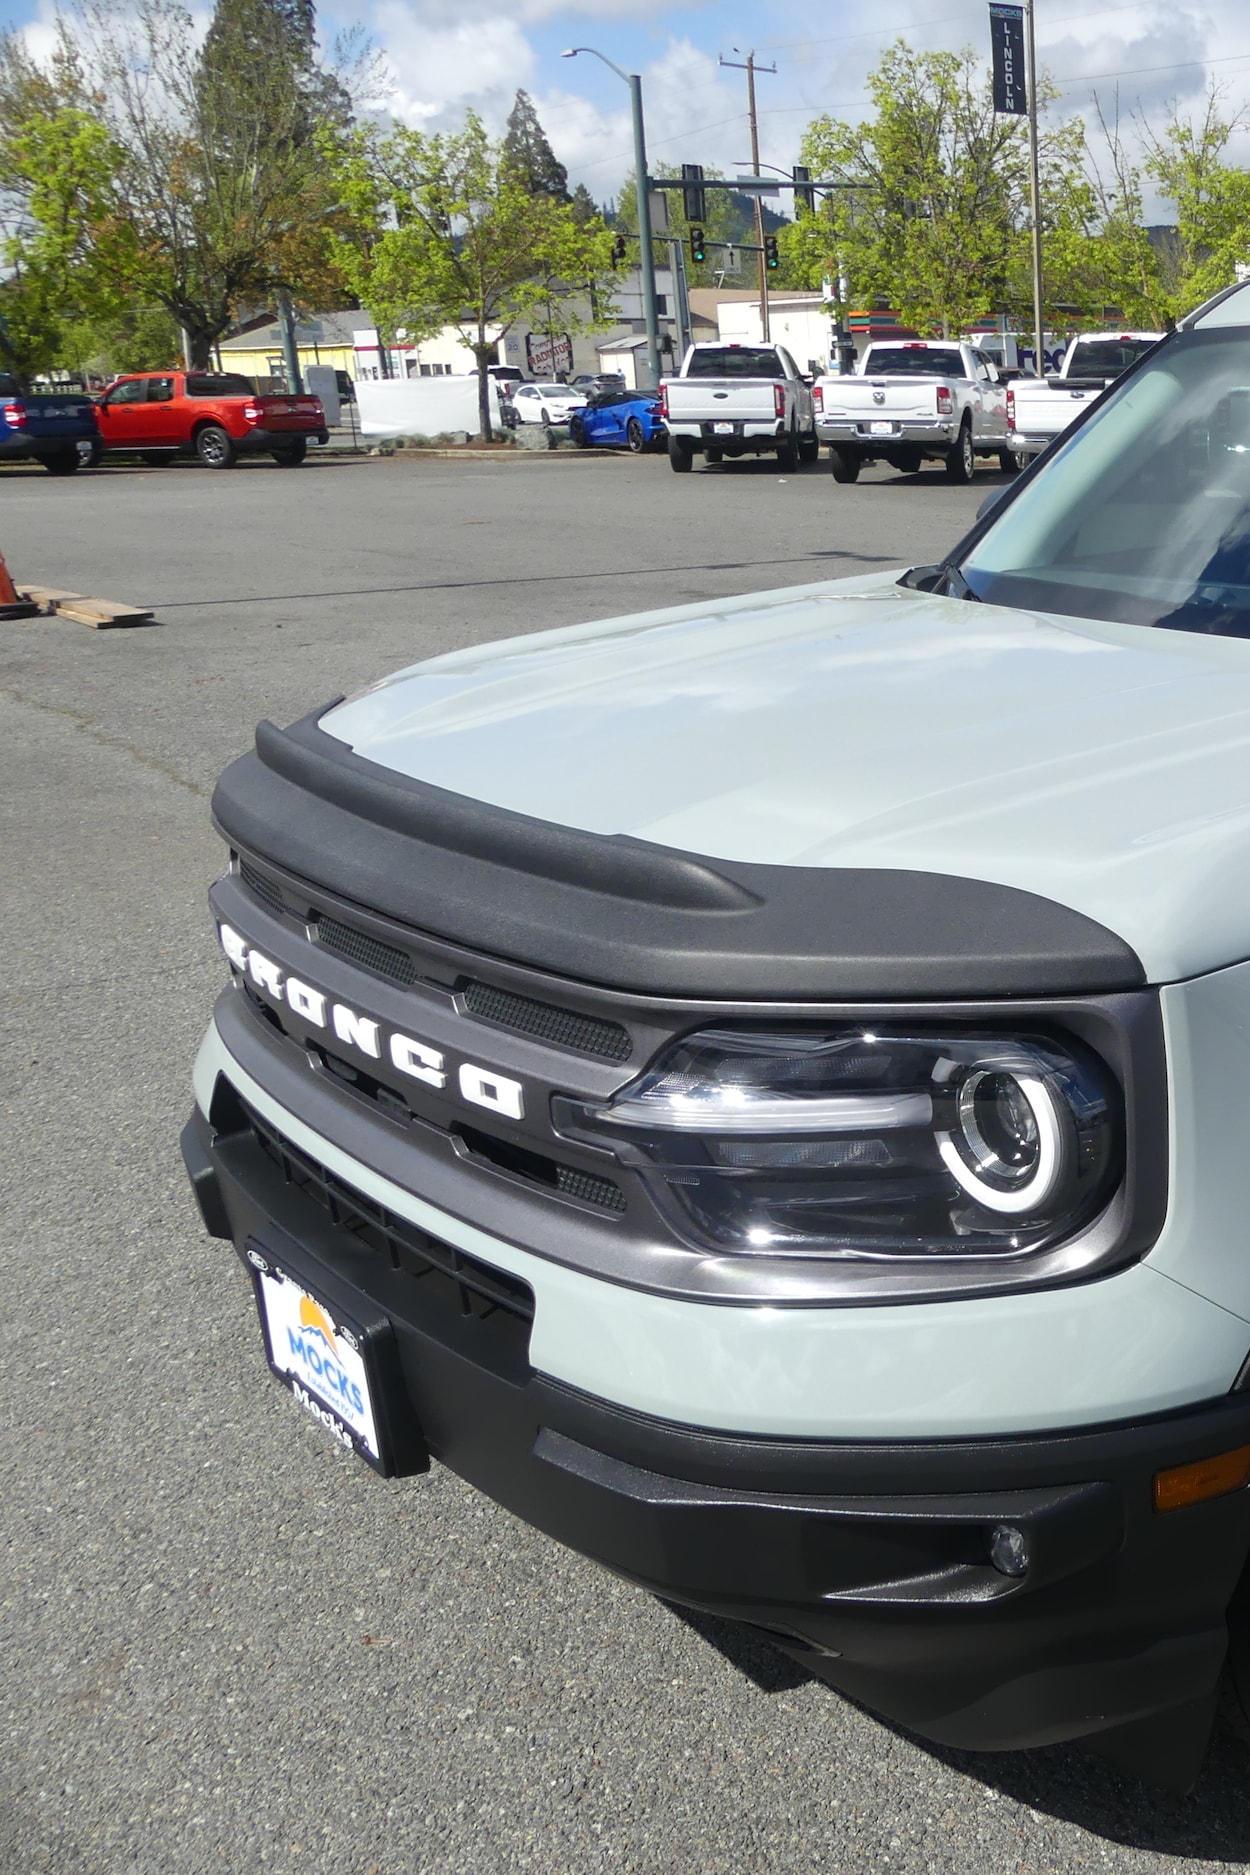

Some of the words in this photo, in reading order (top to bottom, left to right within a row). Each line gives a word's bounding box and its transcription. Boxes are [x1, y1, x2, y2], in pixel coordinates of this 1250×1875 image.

[1003, 21, 1015, 110] LINCOLN
[221, 923, 525, 1120] BRONCO
[286, 1324, 365, 1416] MOCKS
[291, 1380, 354, 1449] Mock's
